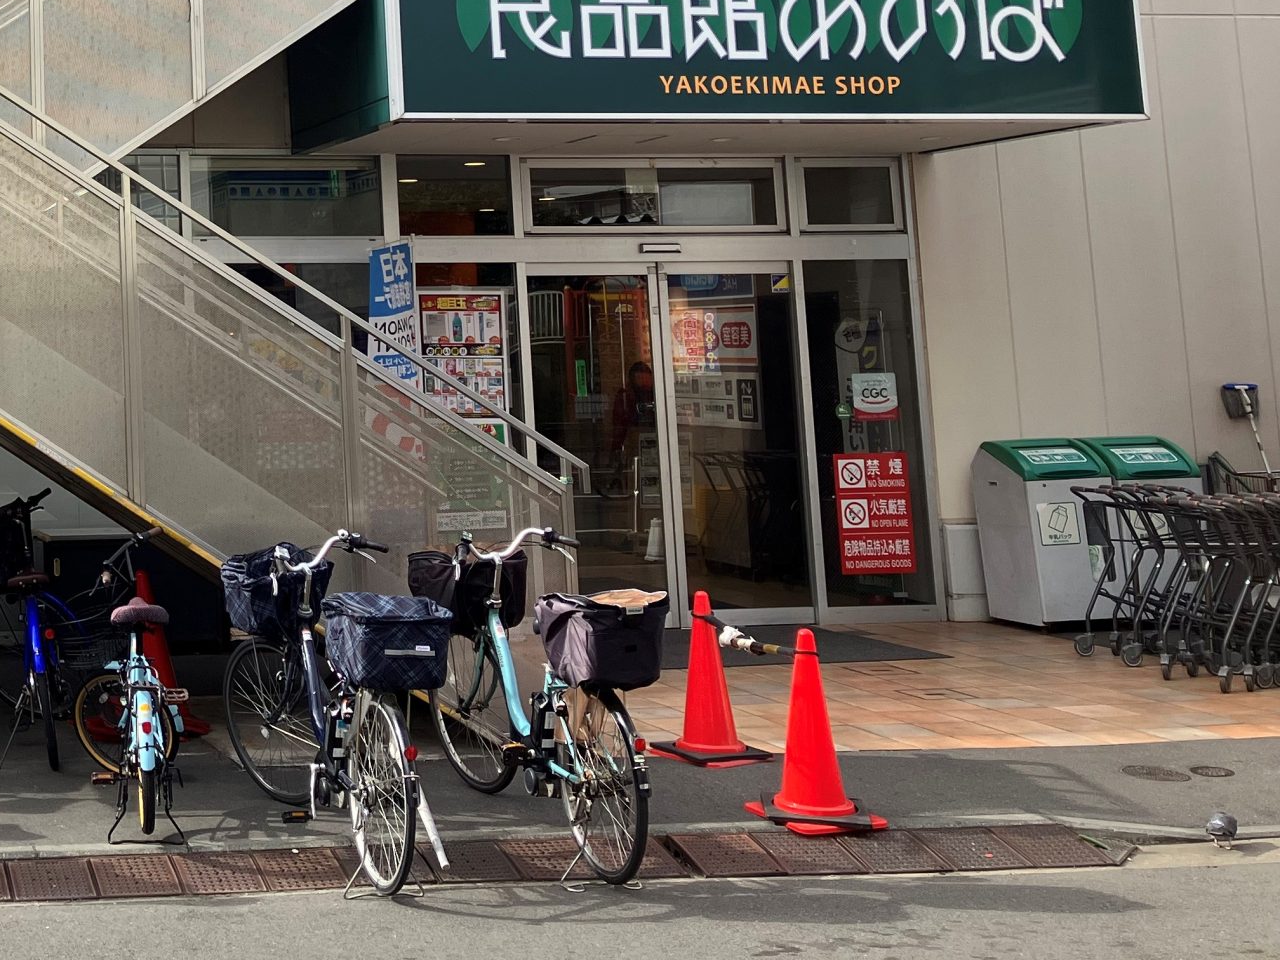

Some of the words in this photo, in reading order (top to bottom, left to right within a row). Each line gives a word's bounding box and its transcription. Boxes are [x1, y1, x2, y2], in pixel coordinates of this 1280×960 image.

[660, 75, 826, 95] YAKOEKIMAE
[835, 76, 901, 95] SHOP
[862, 388, 888, 399] CGC
[866, 458, 904, 477] 禁煙
[867, 480, 877, 488] NO
[878, 479, 905, 488] SMOKING
[870, 499, 907, 516] 火気厳禁
[871, 520, 879, 528] NO
[880, 520, 892, 528] OPEN
[893, 519, 909, 528] FLAME
[846, 561, 855, 569] NO
[855, 560, 890, 569] DANGEROUS
[891, 559, 912, 568] GOODS
